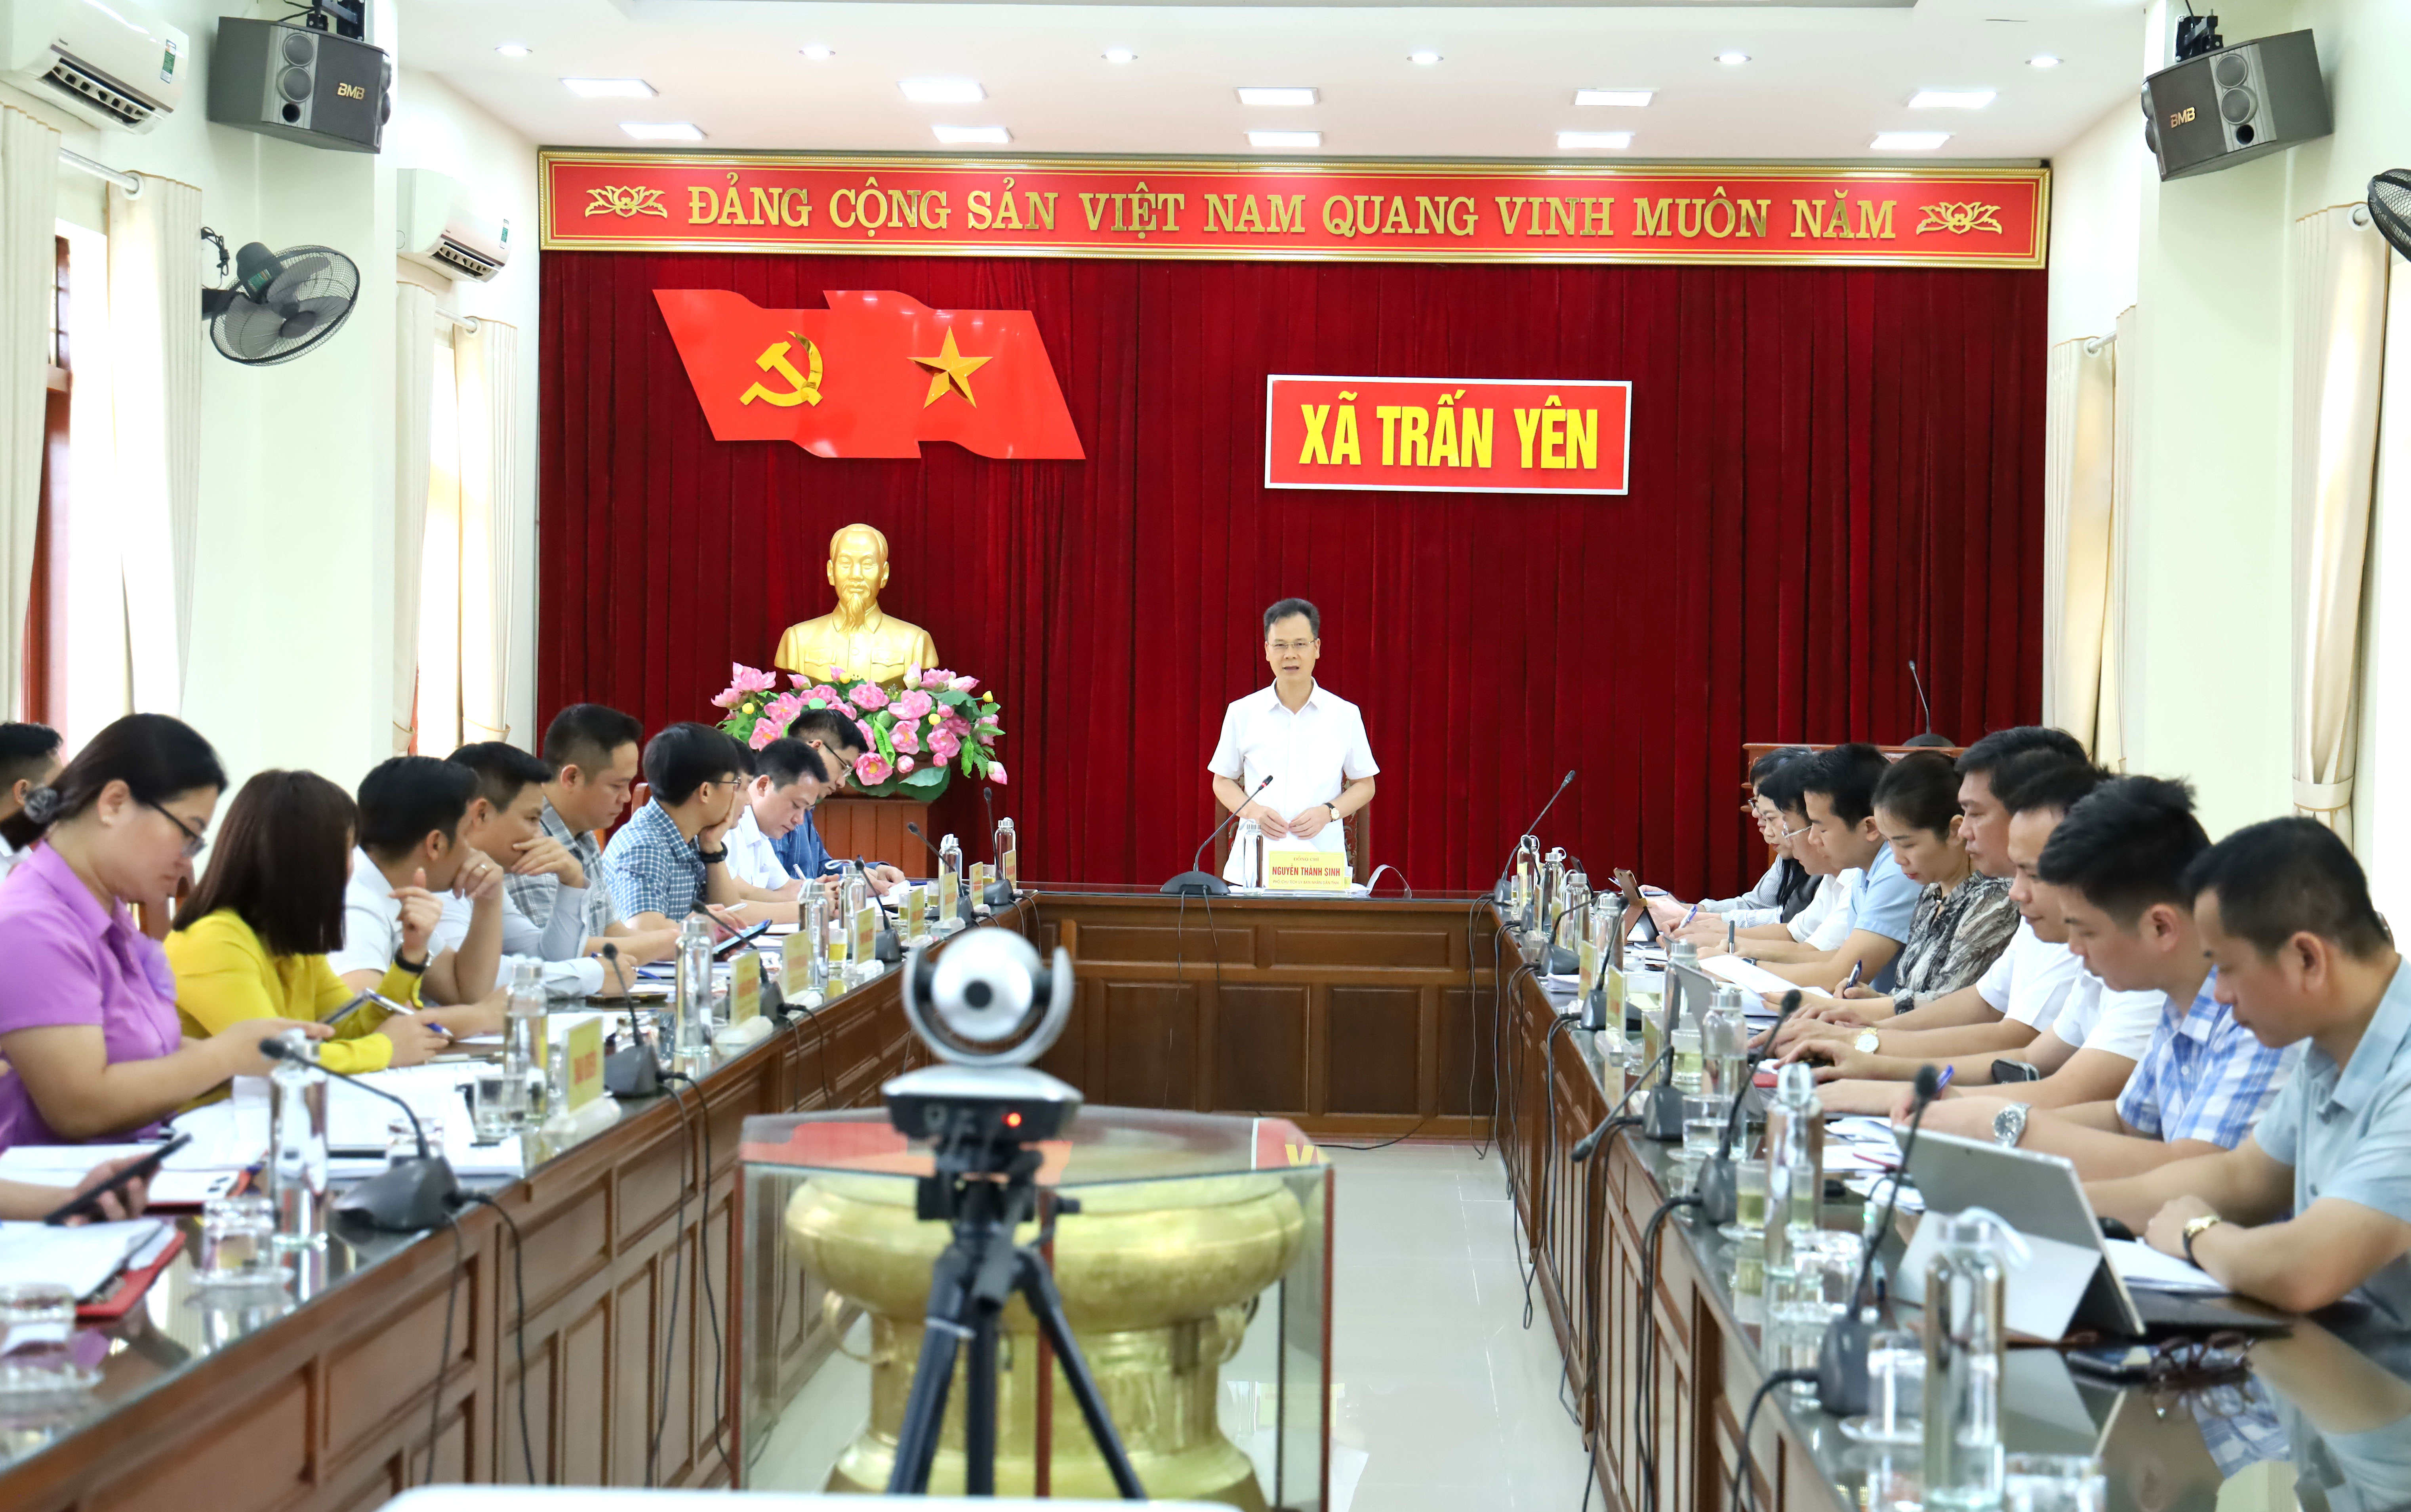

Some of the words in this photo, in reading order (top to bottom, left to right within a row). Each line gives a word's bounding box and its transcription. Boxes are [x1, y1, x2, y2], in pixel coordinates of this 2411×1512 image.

[337, 83, 365, 100] BMB
[2171, 107, 2196, 128] BMB
[688, 171, 812, 227] ĐẢNG
[829, 176, 951, 238] CỘNG
[967, 177, 1058, 230] SẢN
[1079, 181, 1185, 239] VIỆT
[1204, 194, 1306, 234] NAM
[1323, 195, 1479, 238] QUANG
[1495, 197, 1614, 236] VINH
[1632, 186, 1771, 238] MUÔN
[1790, 189, 1897, 239] NĂM
[1299, 390, 1361, 465] XÃ
[1376, 389, 1493, 468] TRẤN
[1513, 394, 1598, 469] YÊN
[1272, 863, 1298, 876] NGUYỄN
[1301, 865, 1322, 876] THÀNH
[1325, 867, 1340, 876] SINH
